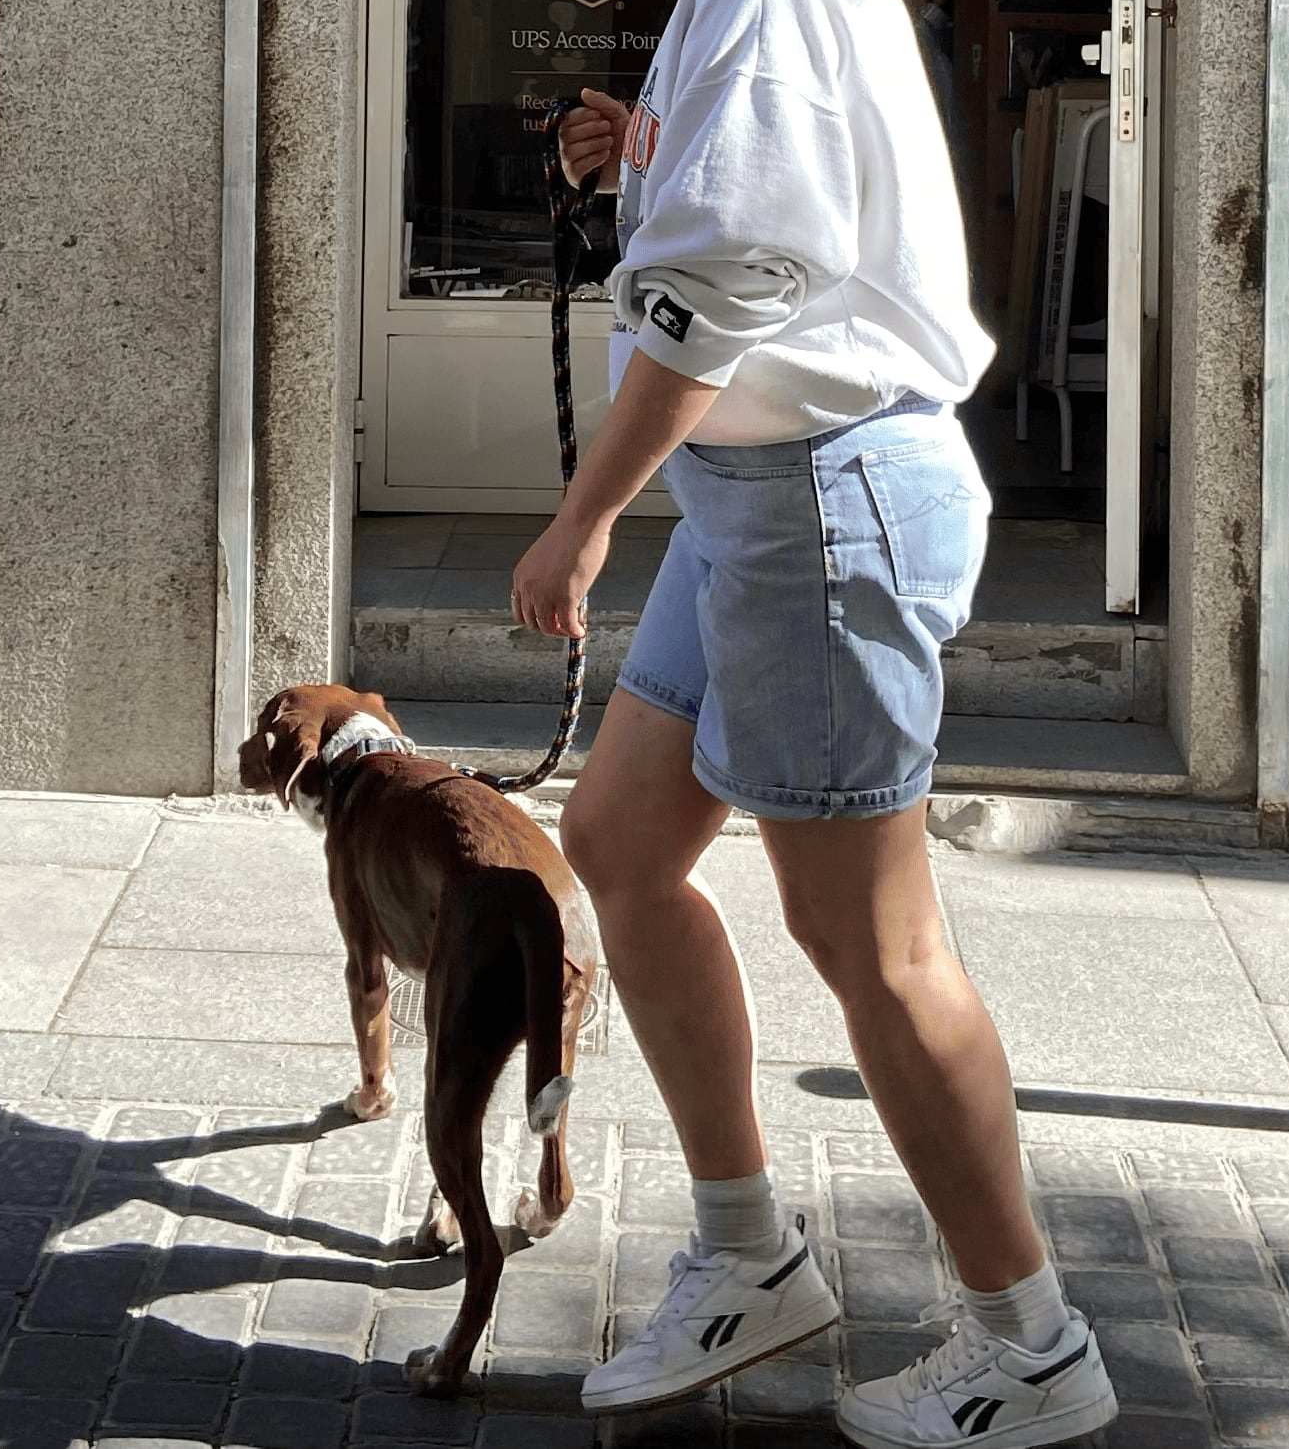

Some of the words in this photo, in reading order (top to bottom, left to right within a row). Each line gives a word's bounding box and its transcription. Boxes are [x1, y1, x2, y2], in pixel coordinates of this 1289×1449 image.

[511, 30, 550, 50] UPS
[554, 30, 617, 50] Access
[621, 31, 662, 50] Poin
